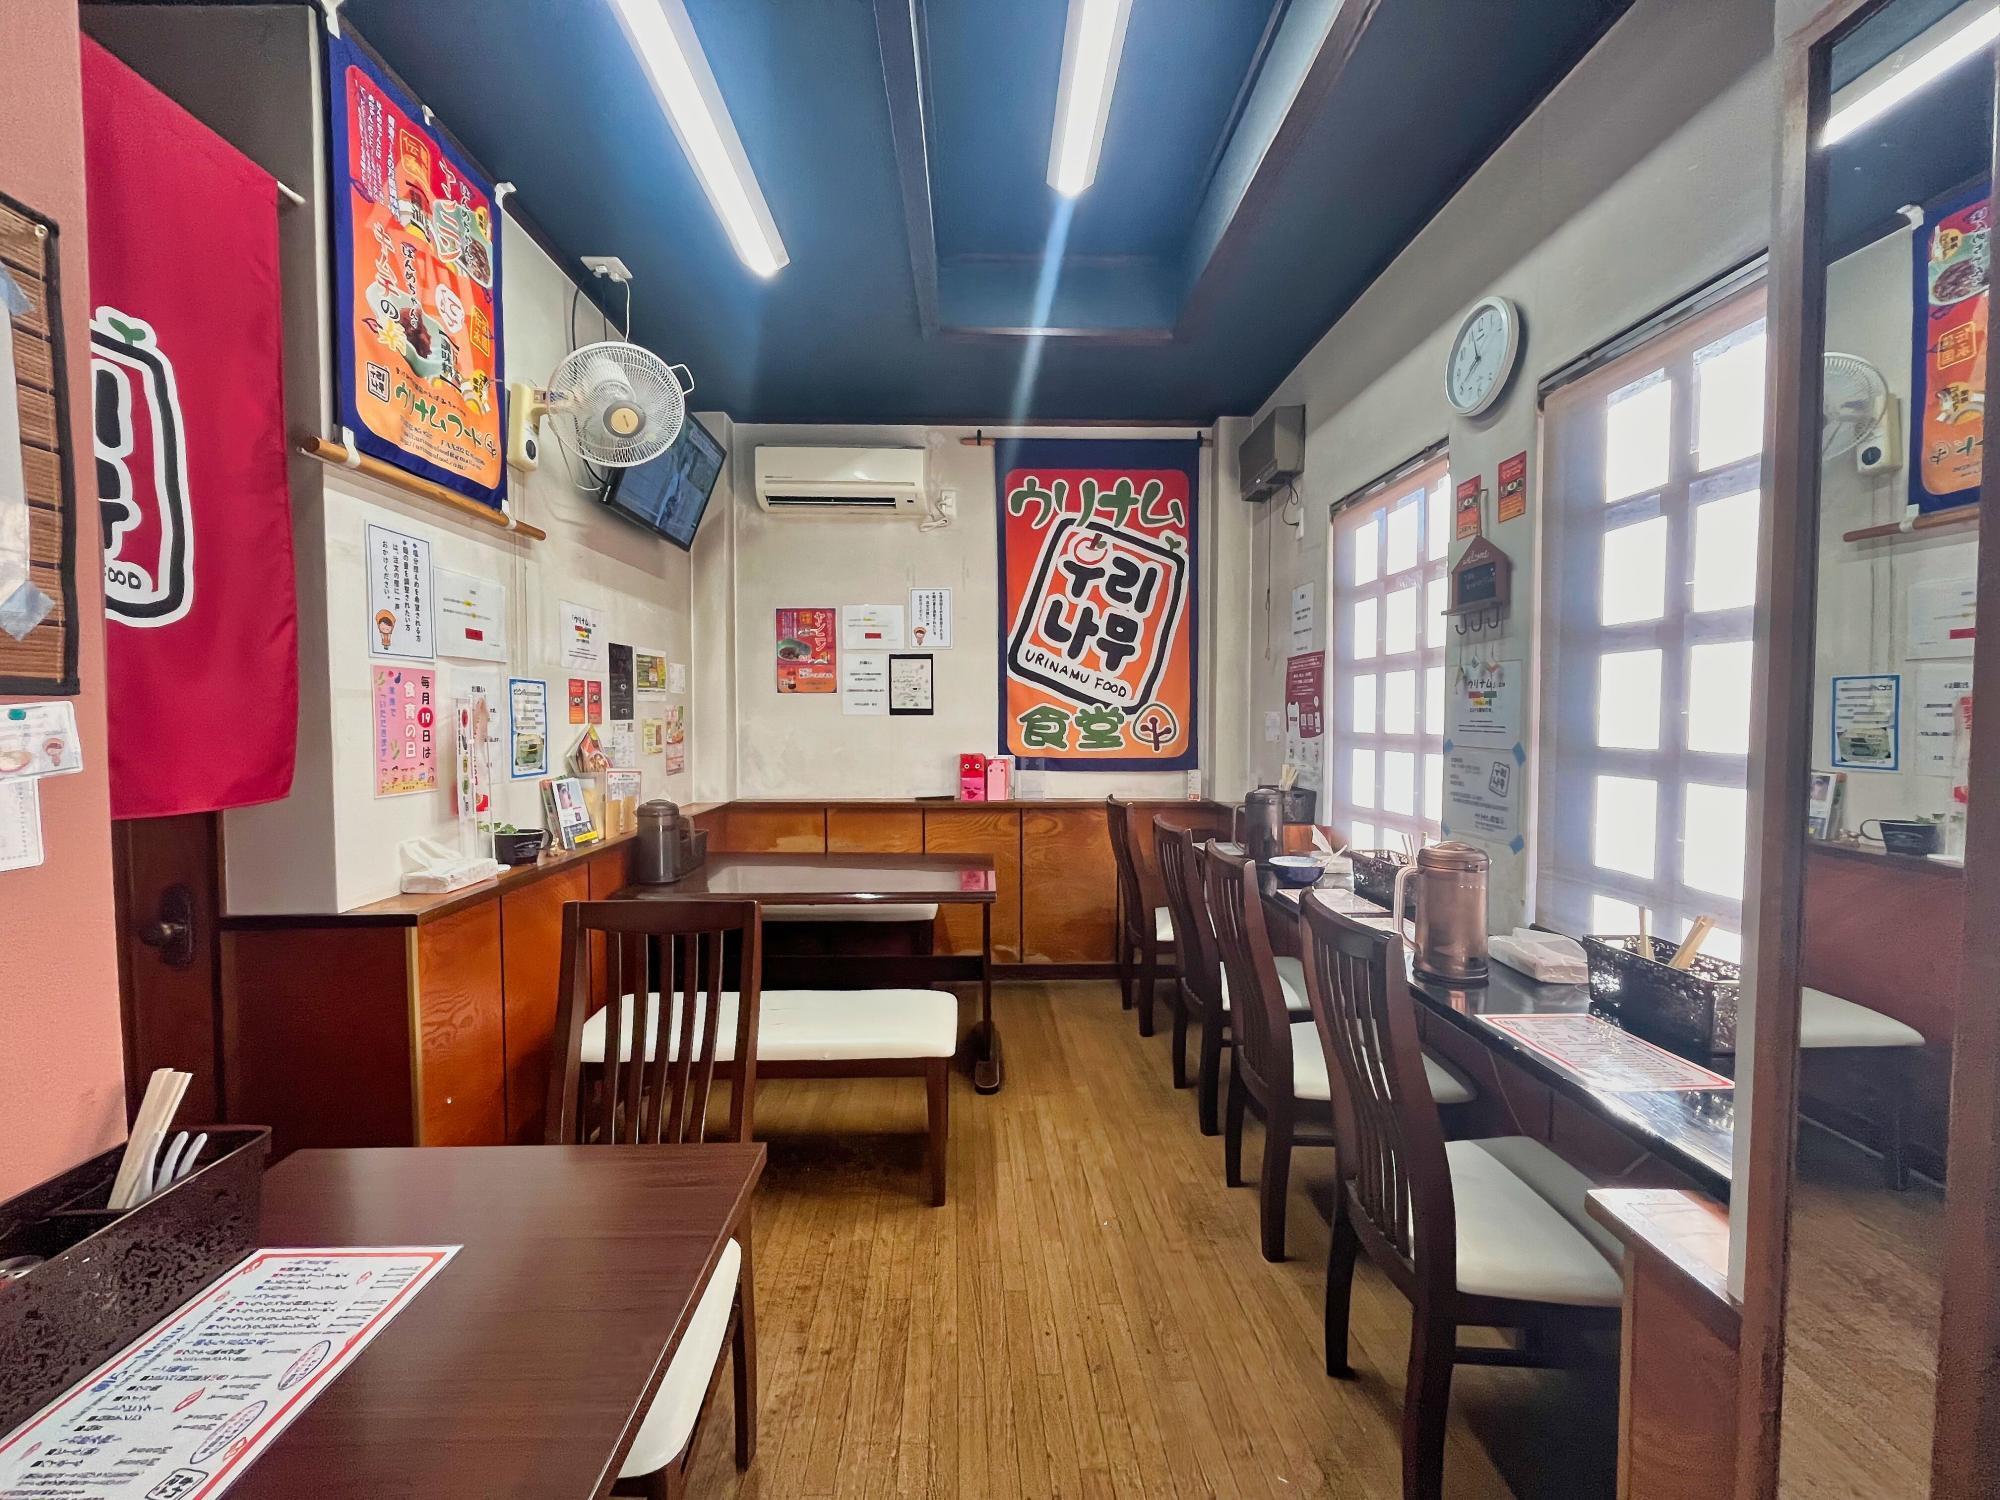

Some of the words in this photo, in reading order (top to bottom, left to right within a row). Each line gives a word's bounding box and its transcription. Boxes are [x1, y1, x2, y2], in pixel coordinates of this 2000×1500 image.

[395, 381, 483, 447] ウリナムフード
[1010, 477, 1184, 528] ウリナム
[104, 565, 142, 590] OOD
[1063, 533, 1158, 613] 우리
[1044, 599, 1141, 671] 나무
[1025, 648, 1090, 684] URINAMU
[1095, 677, 1127, 698] FOOD
[404, 681, 417, 758] 食育の日
[421, 676, 432, 759] 毎月19日は
[1019, 705, 1125, 750] 食堂
